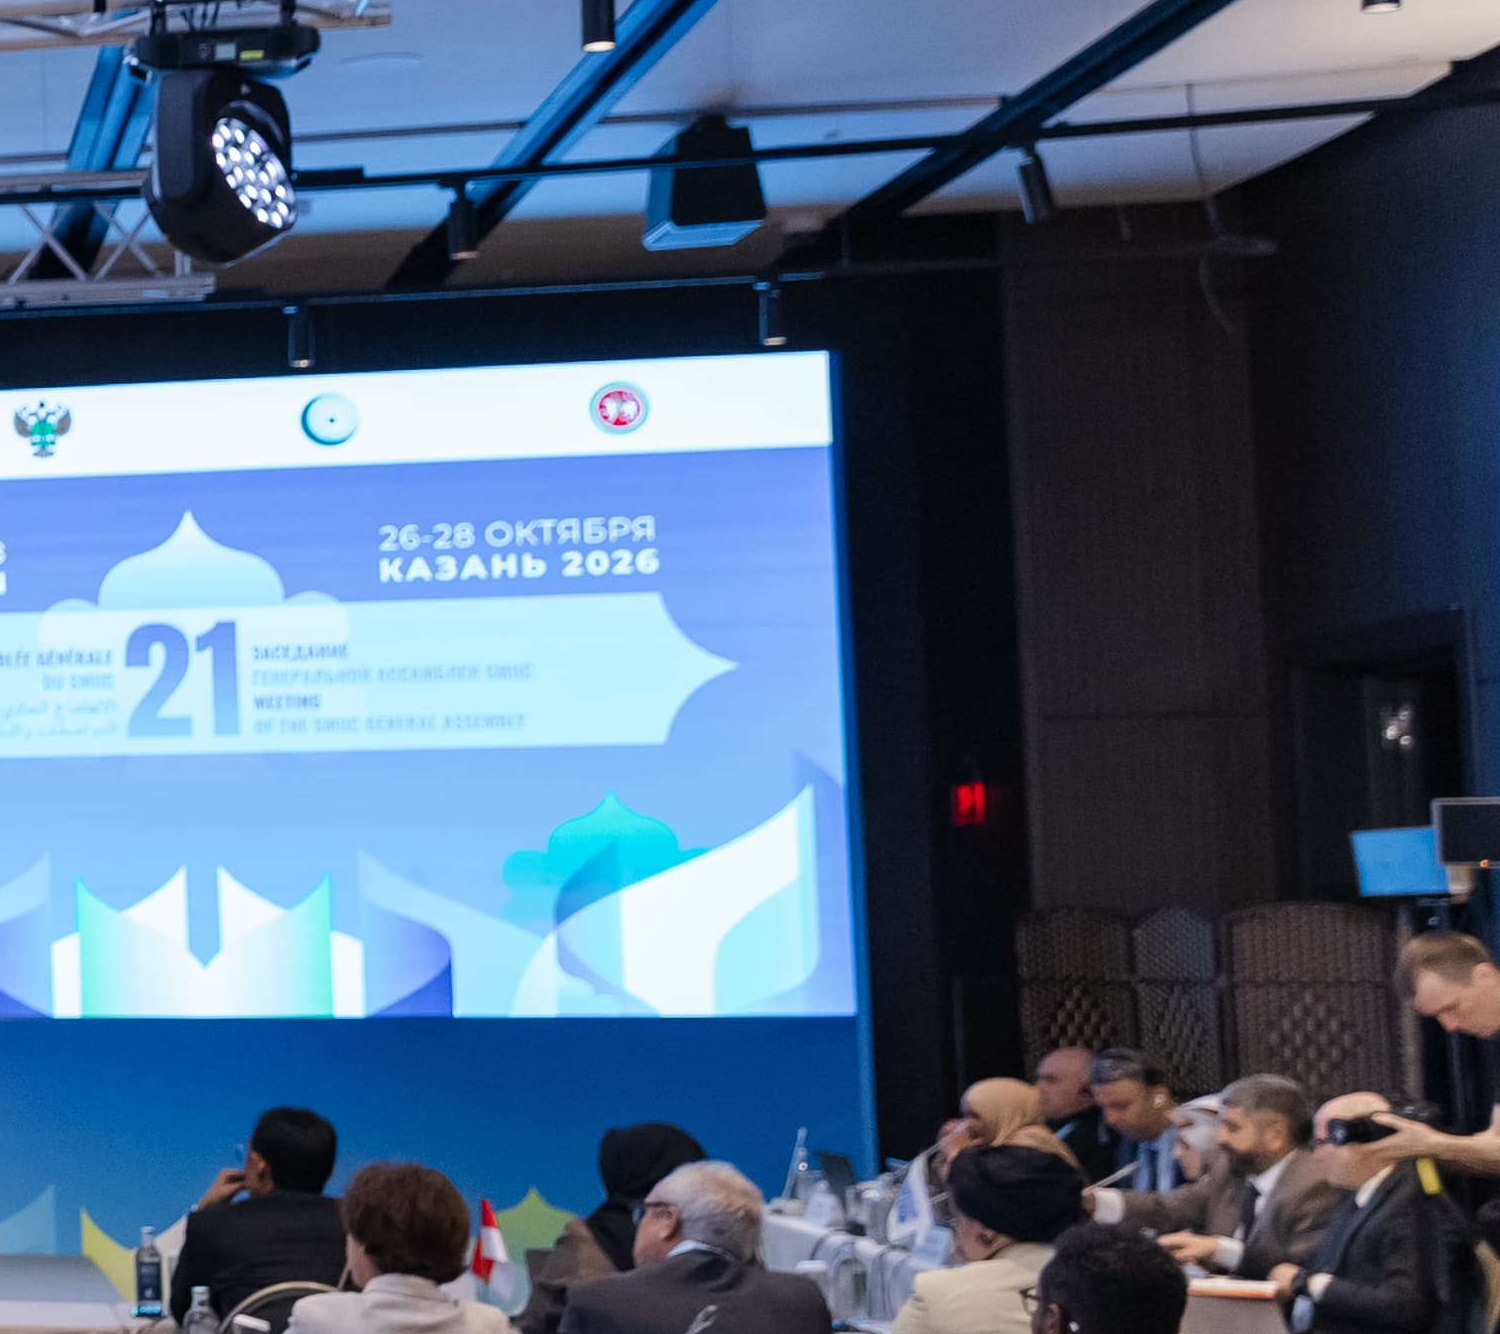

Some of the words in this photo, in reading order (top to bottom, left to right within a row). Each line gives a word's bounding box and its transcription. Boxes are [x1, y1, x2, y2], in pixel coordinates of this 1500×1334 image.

[379, 522, 476, 553] 26-28
[484, 514, 656, 548] ОКТЯБРЯ
[379, 553, 546, 584] КАЗАНЬ
[562, 548, 661, 578] 2026
[124, 619, 240, 739] 21
